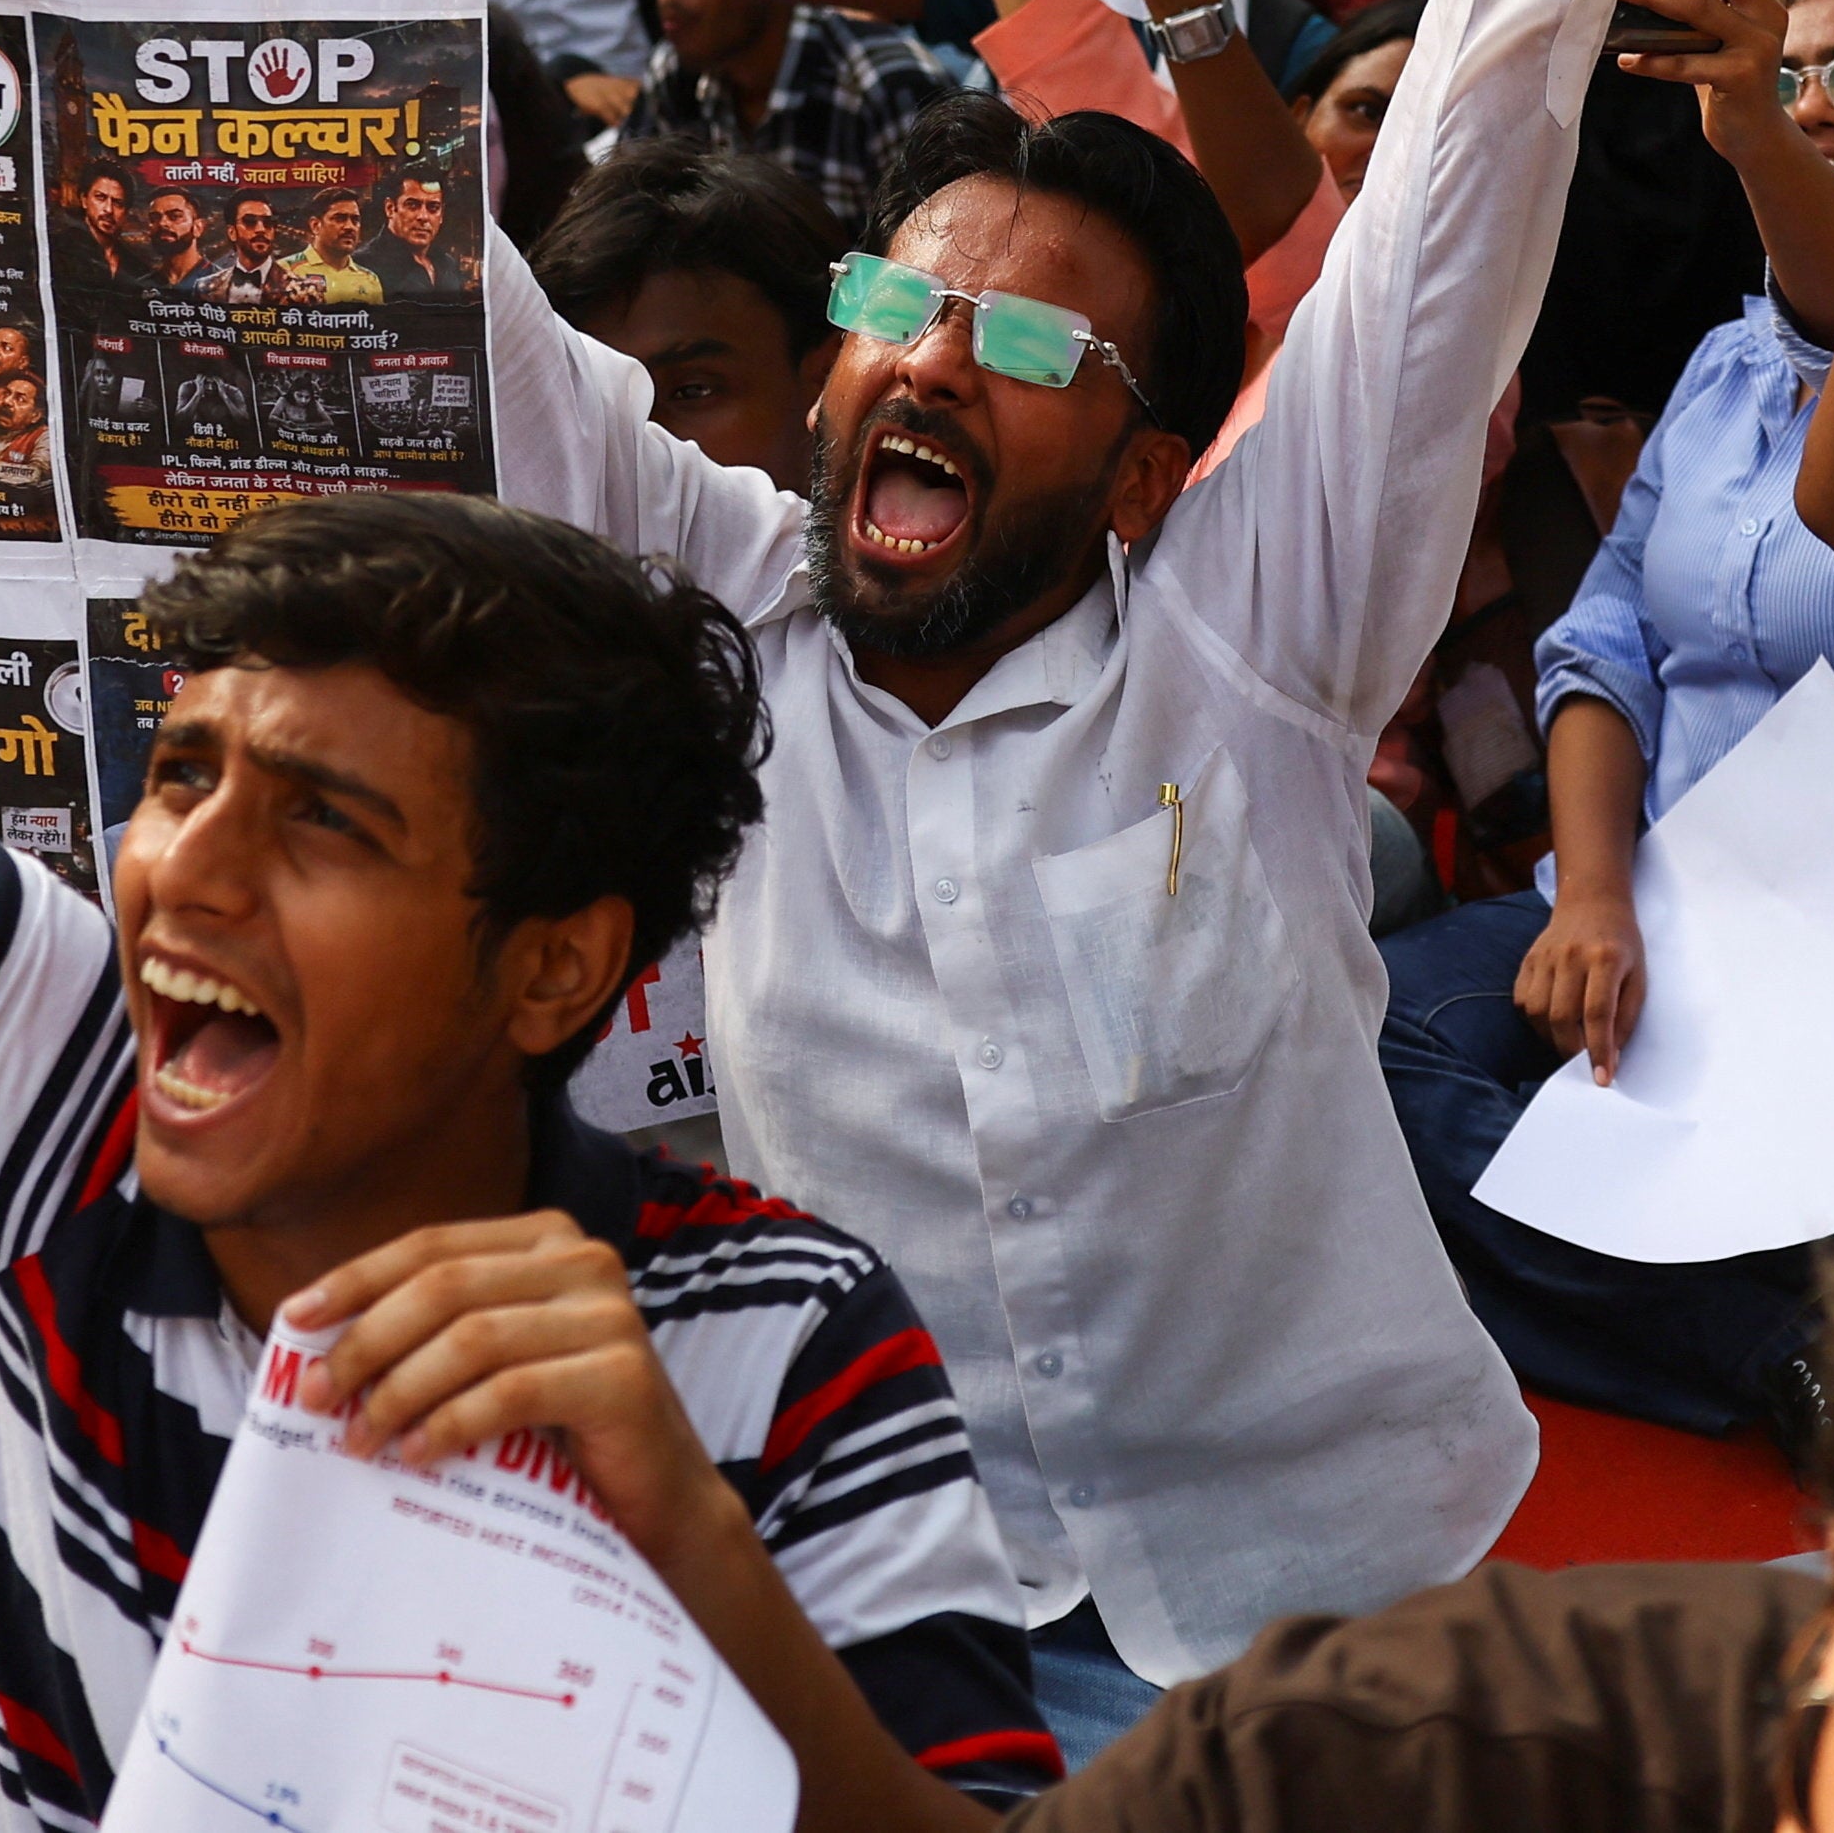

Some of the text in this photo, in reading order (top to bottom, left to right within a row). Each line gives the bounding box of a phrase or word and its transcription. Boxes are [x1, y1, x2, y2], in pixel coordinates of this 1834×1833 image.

[135, 38, 375, 105] STOP
[92, 93, 203, 157] फैन
[165, 161, 203, 182] ताली
[243, 167, 286, 184] जवाब
[292, 162, 345, 184] चाहिए!
